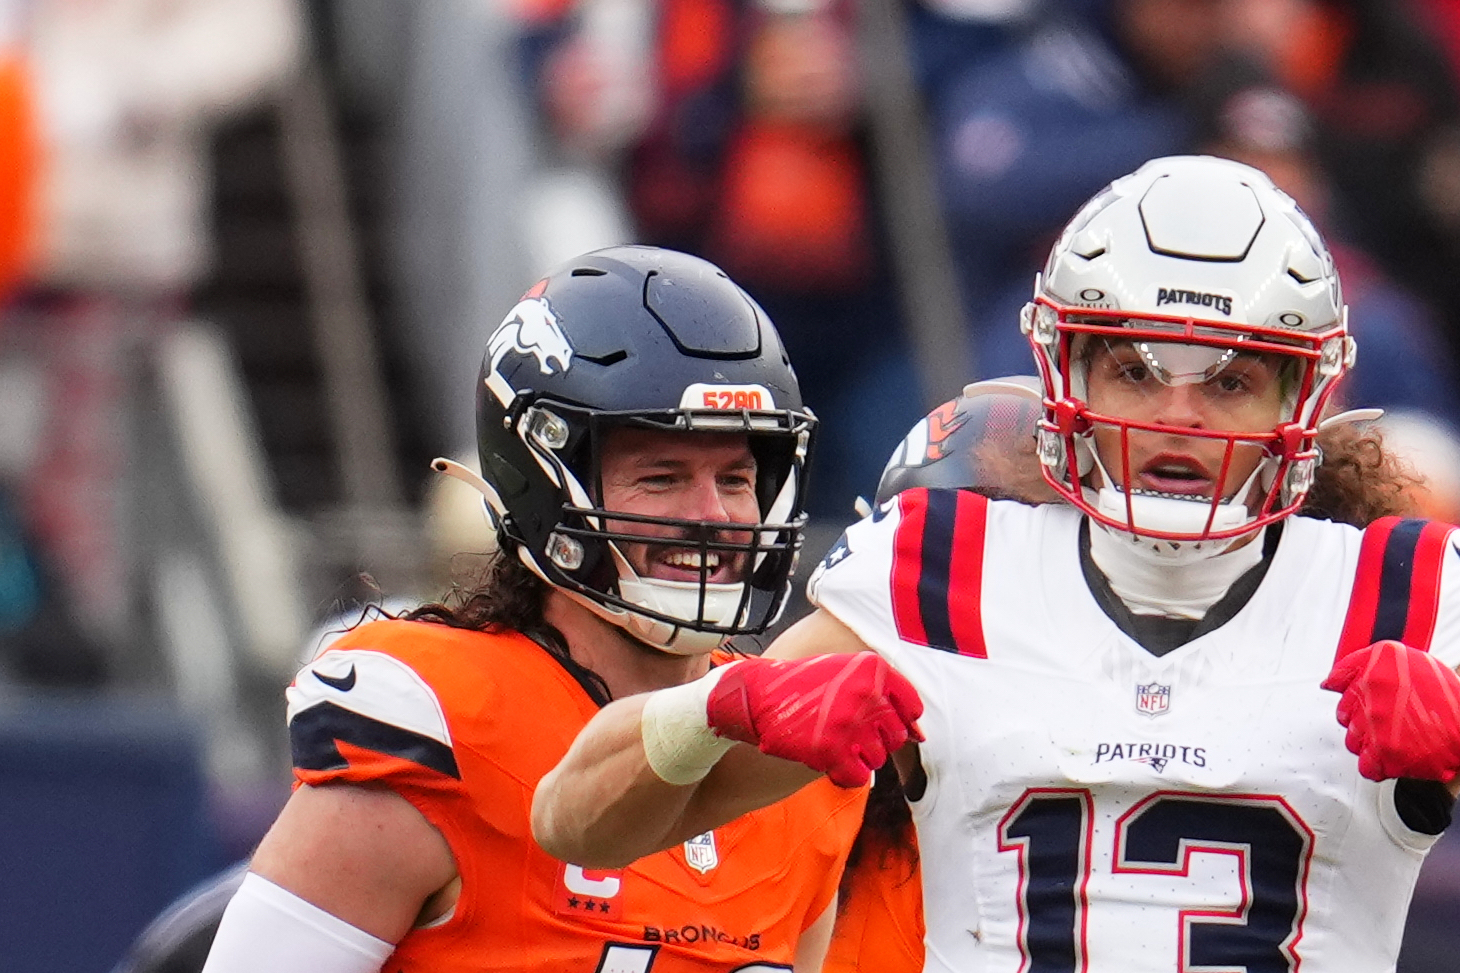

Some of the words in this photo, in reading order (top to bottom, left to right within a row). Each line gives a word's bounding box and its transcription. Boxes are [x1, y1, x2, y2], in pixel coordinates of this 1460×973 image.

[1156, 288, 1233, 316] PATRIOTS
[1140, 694, 1167, 711] NFL
[1095, 743, 1206, 768] PATRIOTS
[690, 845, 713, 863] NFL
